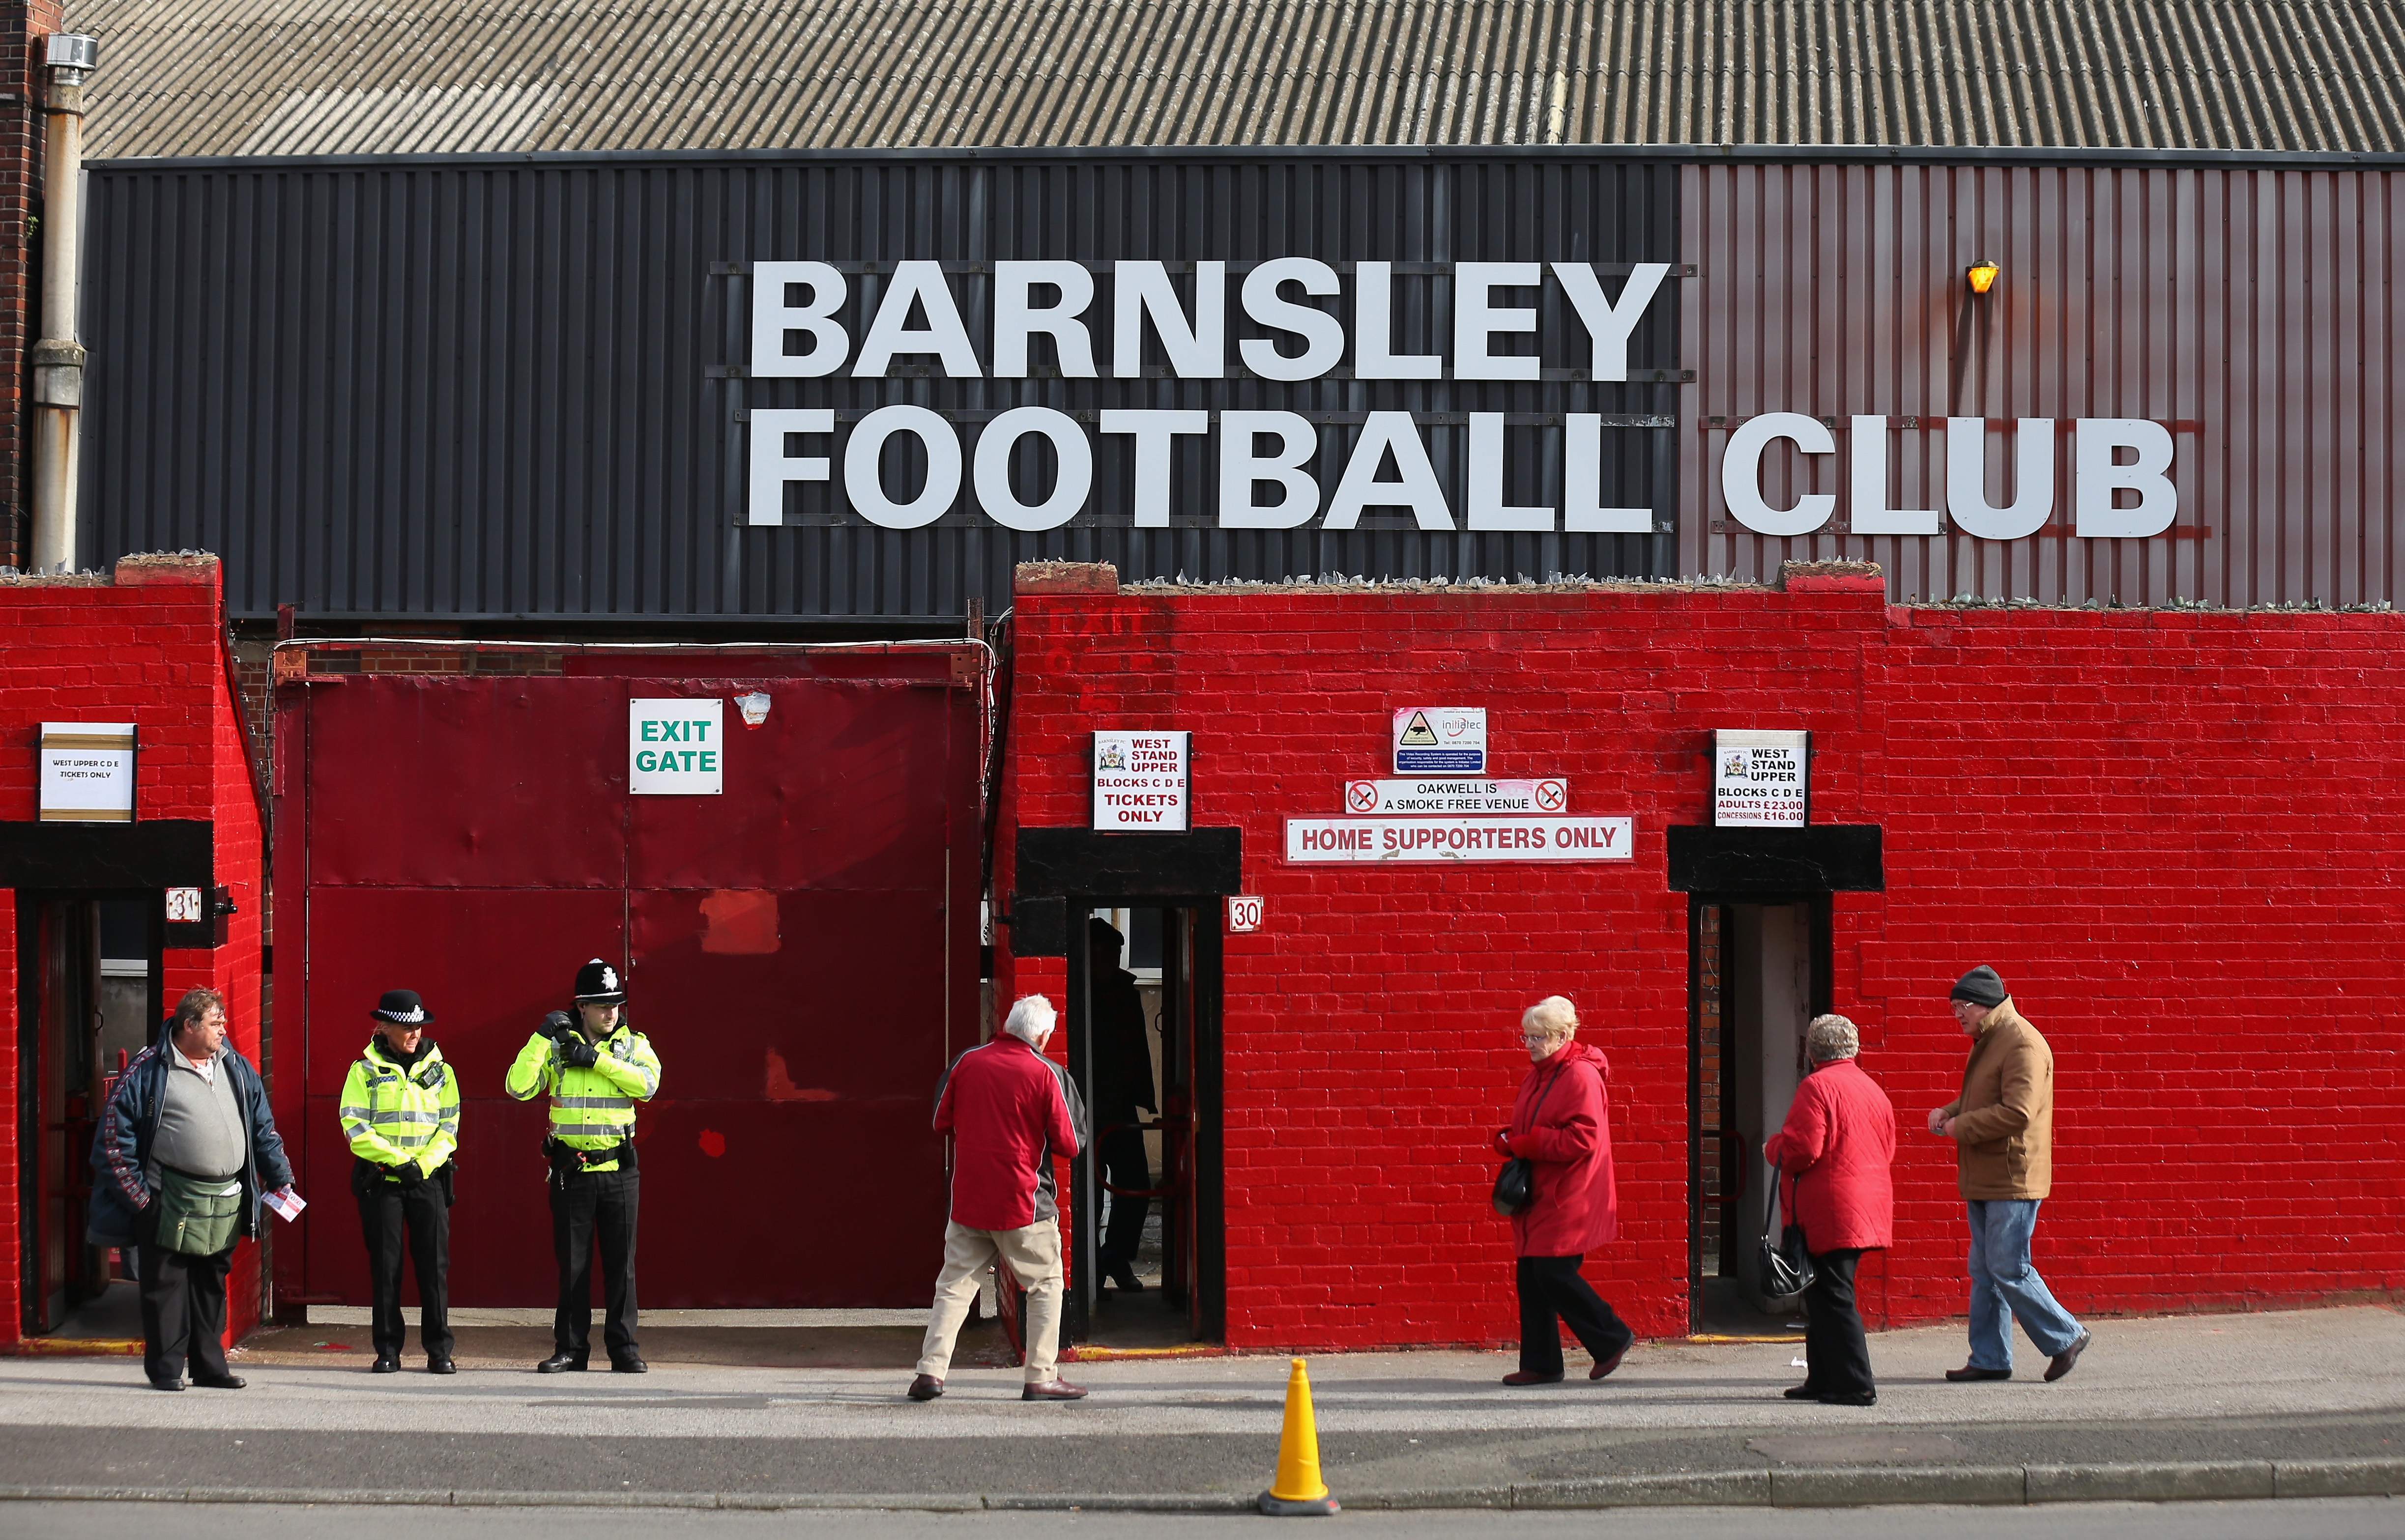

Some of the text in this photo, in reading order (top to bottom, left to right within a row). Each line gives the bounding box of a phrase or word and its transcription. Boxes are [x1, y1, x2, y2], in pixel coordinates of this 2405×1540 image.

[751, 257, 1671, 381] BARNSLEY
[749, 404, 2177, 540] FOOTBALL CLUB
[1442, 720, 1481, 729] initiatec
[641, 720, 711, 741] EXIT
[1131, 739, 1170, 748] WEST
[1131, 751, 1177, 760] STAND
[1751, 749, 1789, 758] WEST
[636, 751, 716, 771] GATE
[1751, 761, 1796, 770] STAND
[1131, 763, 1178, 772] UPPER
[1751, 772, 1796, 781] UPPER
[1097, 778, 1185, 787] BLOCKS C D E
[1417, 783, 1497, 794] OAKWELL IS
[1718, 788, 1767, 797] BLOCKS
[1771, 789, 1779, 797] C
[1104, 794, 1178, 805] TICKETS
[1384, 798, 1529, 810] A SMOKE FREE VENUE
[1764, 801, 1803, 809] £23.00
[1118, 810, 1163, 822] ONLY
[1764, 812, 1803, 820] £16.00
[1302, 827, 1617, 850] HOME SUPPORTERS ONLY
[174, 893, 193, 917] 31
[1235, 902, 1258, 926] 30
